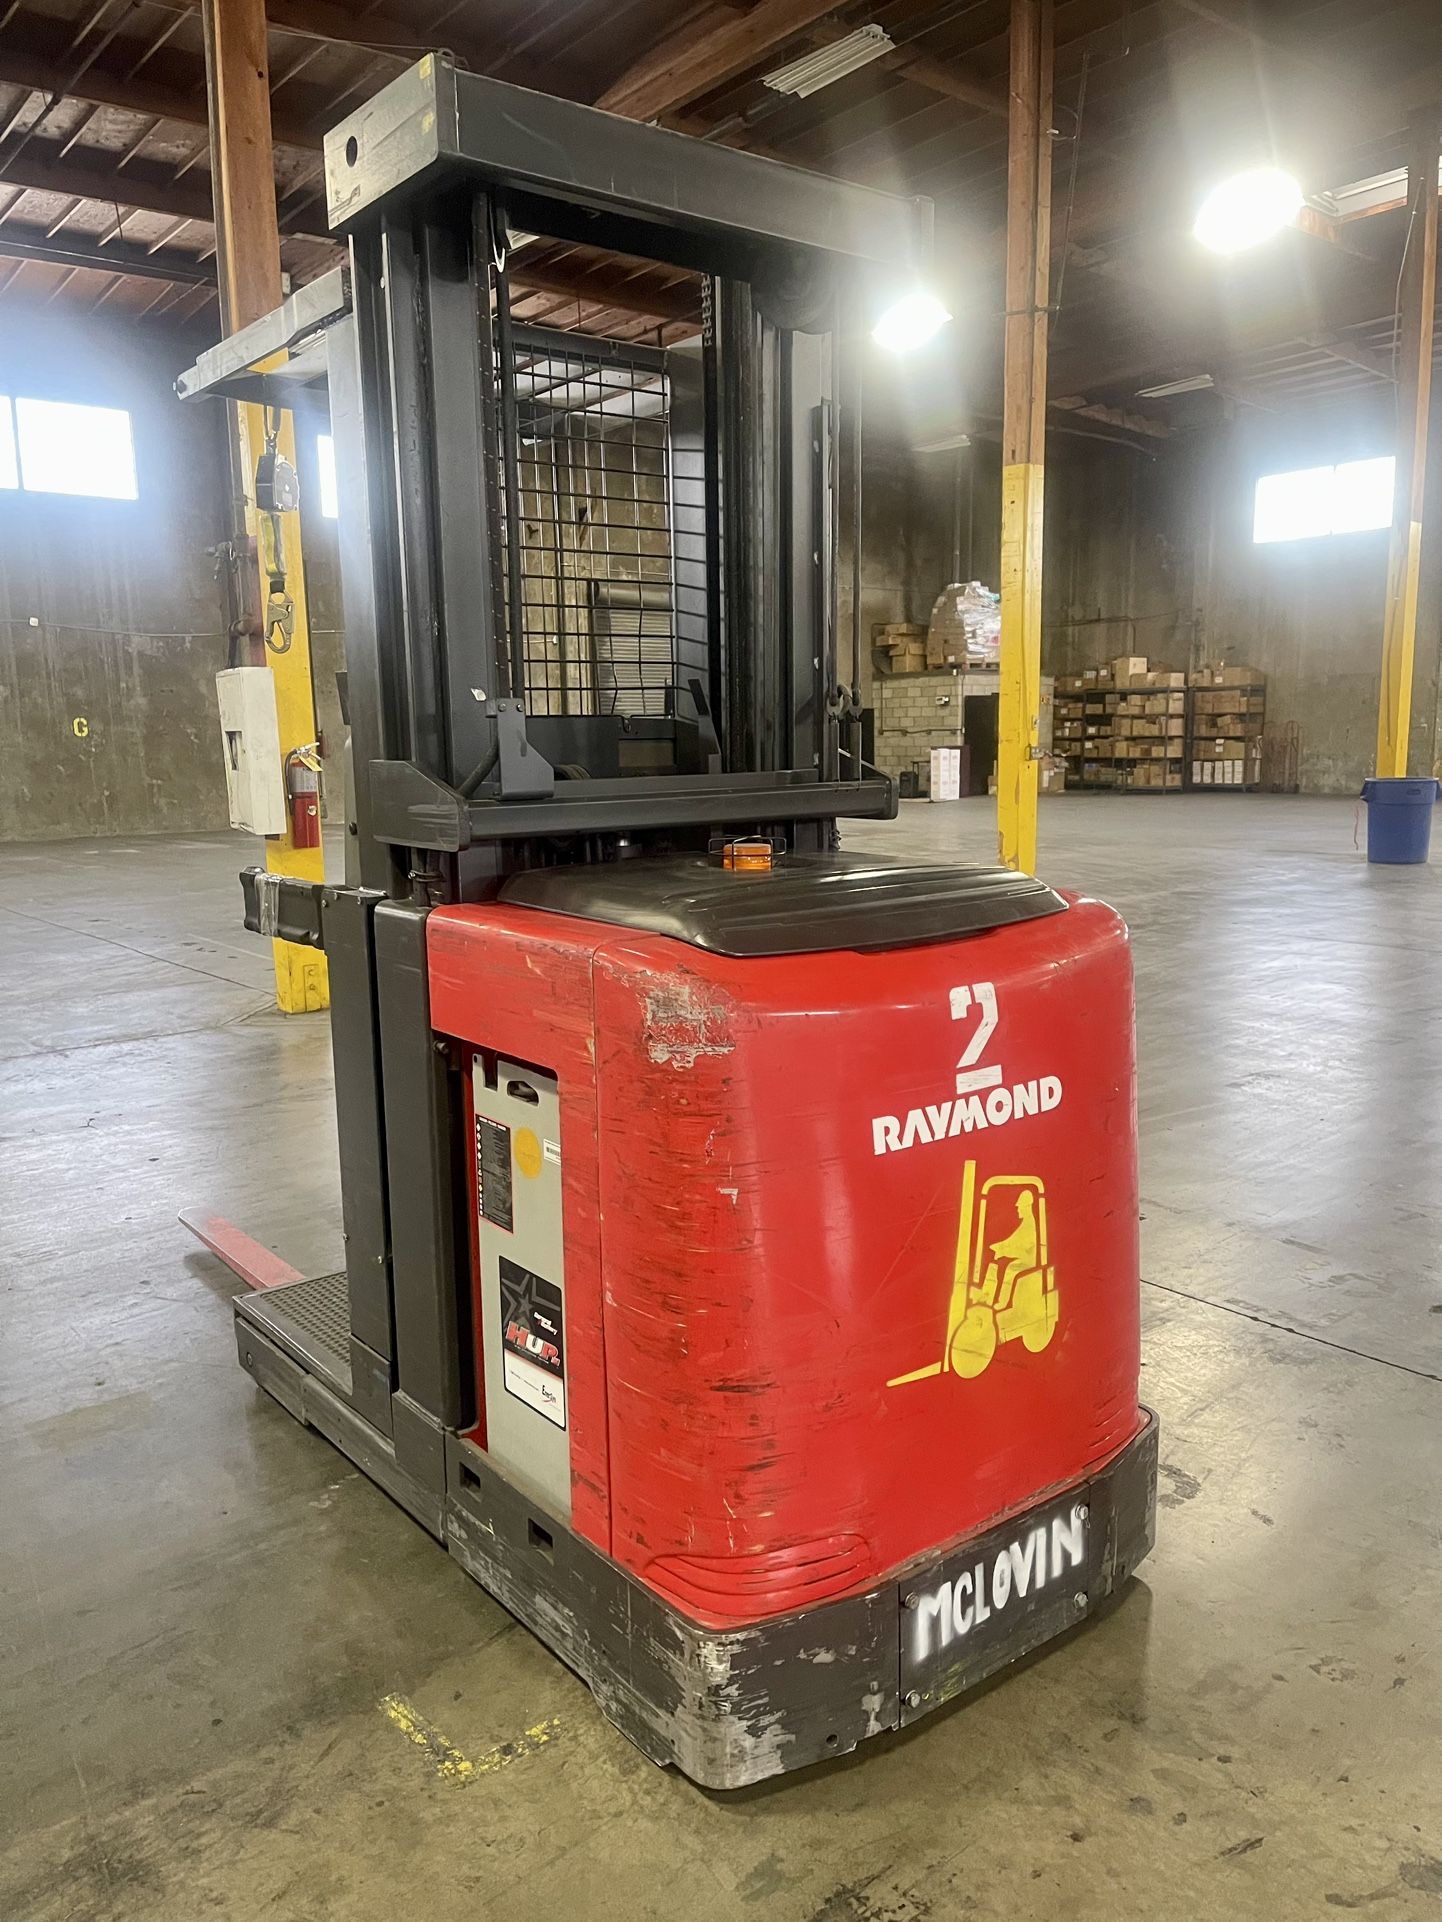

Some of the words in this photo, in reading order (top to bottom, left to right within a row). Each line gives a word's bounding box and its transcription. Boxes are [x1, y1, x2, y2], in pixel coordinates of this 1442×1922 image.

[71, 717, 89, 737] G
[949, 982, 1003, 1095] 2
[872, 1075, 1063, 1156] RAYMOND
[914, 1504, 1085, 1663] MCLOVIN
